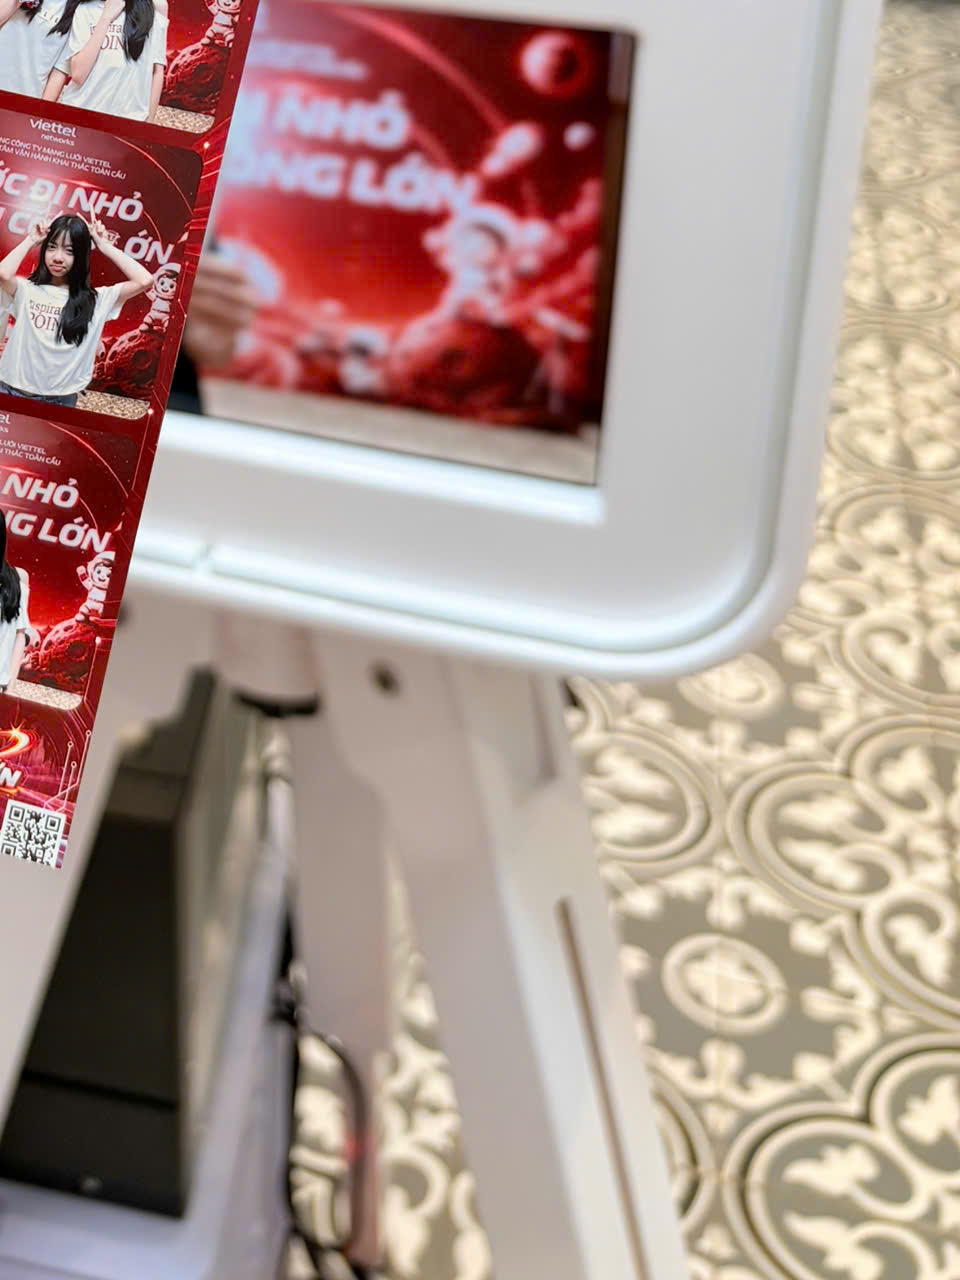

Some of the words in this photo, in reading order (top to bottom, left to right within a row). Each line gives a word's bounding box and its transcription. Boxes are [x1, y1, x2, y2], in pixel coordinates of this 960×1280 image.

[30, 119, 76, 138] viettel
[10, 139, 31, 150] CÔNG
[32, 144, 43, 152] TY
[83, 156, 111, 168] VIETTEL
[27, 175, 64, 205] ĐI
[68, 181, 143, 221] NHỎ
[122, 230, 174, 267] ỚN
[17, 442, 46, 455] VIETTEL
[2, 467, 78, 508] NHỎ
[38, 518, 111, 555] LỚN
